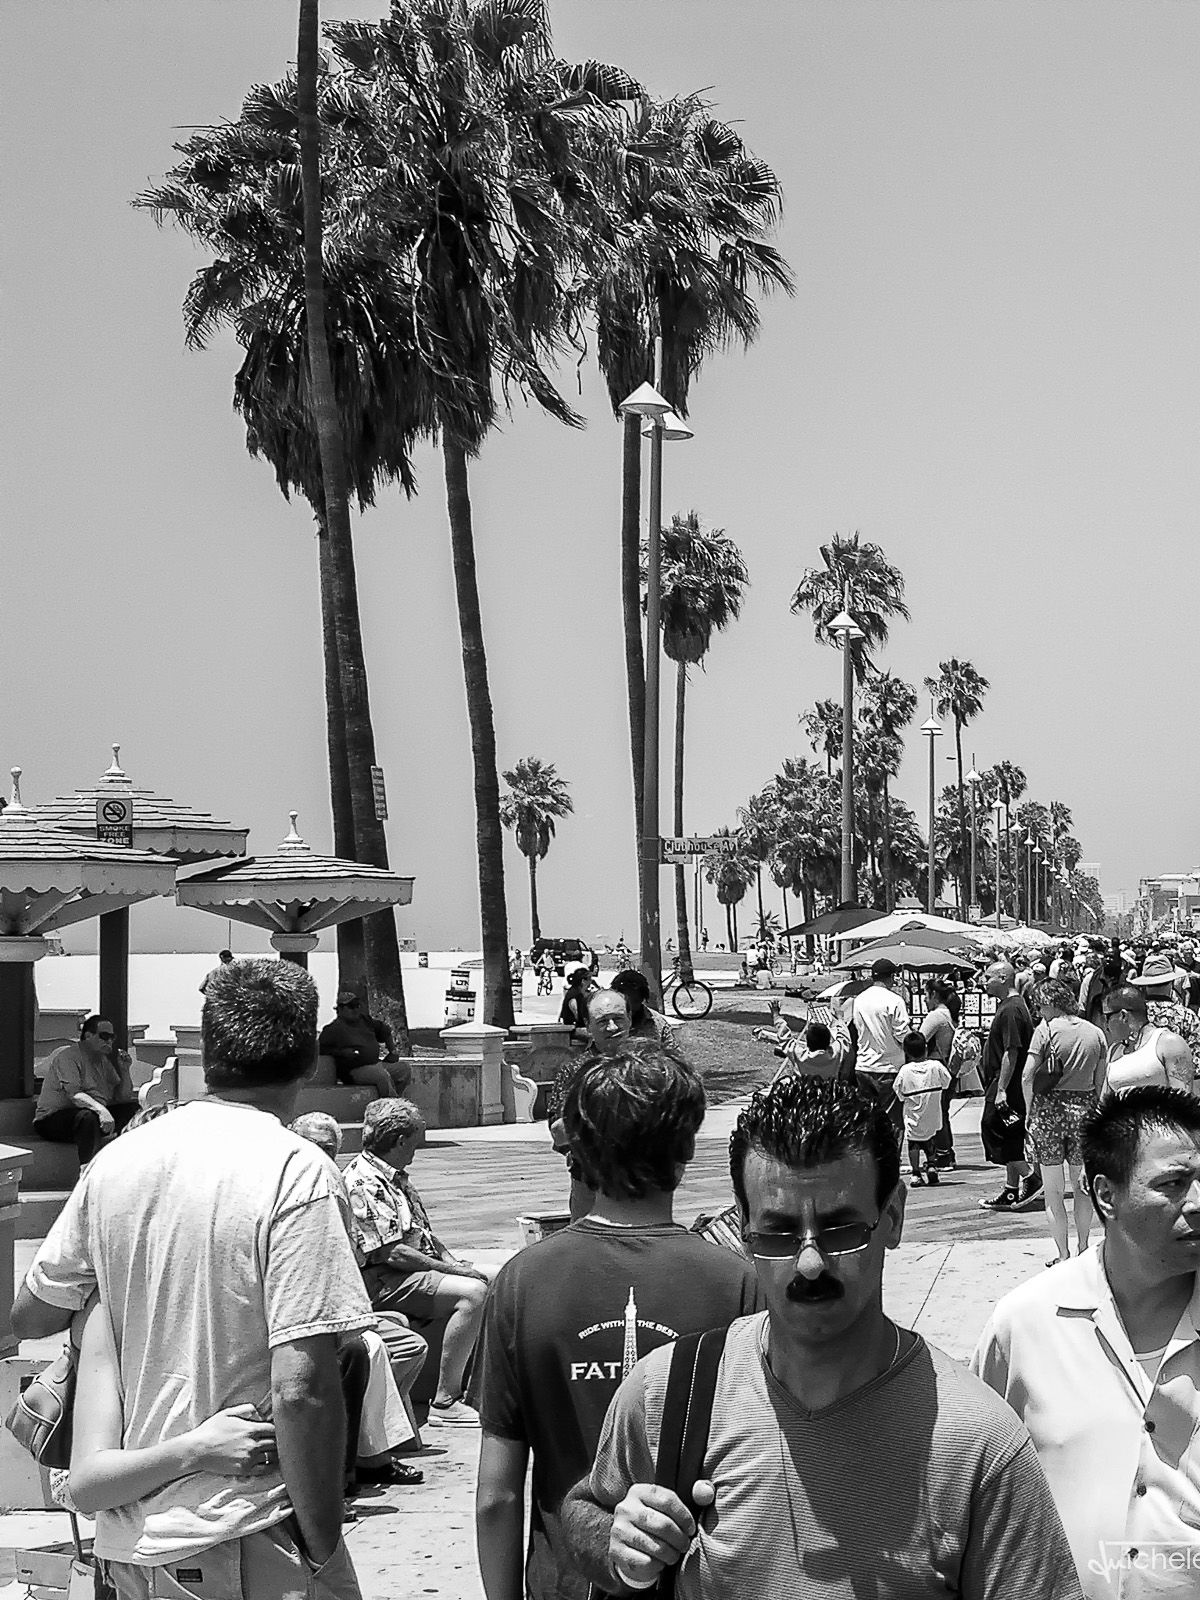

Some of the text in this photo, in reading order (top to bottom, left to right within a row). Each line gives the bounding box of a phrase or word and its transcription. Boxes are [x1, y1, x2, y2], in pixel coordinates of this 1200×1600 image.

[664, 840, 720, 852] Clubhouse
[578, 1319, 680, 1339] RIDE WITH THE BEST
[570, 1361, 622, 1380] FAT
